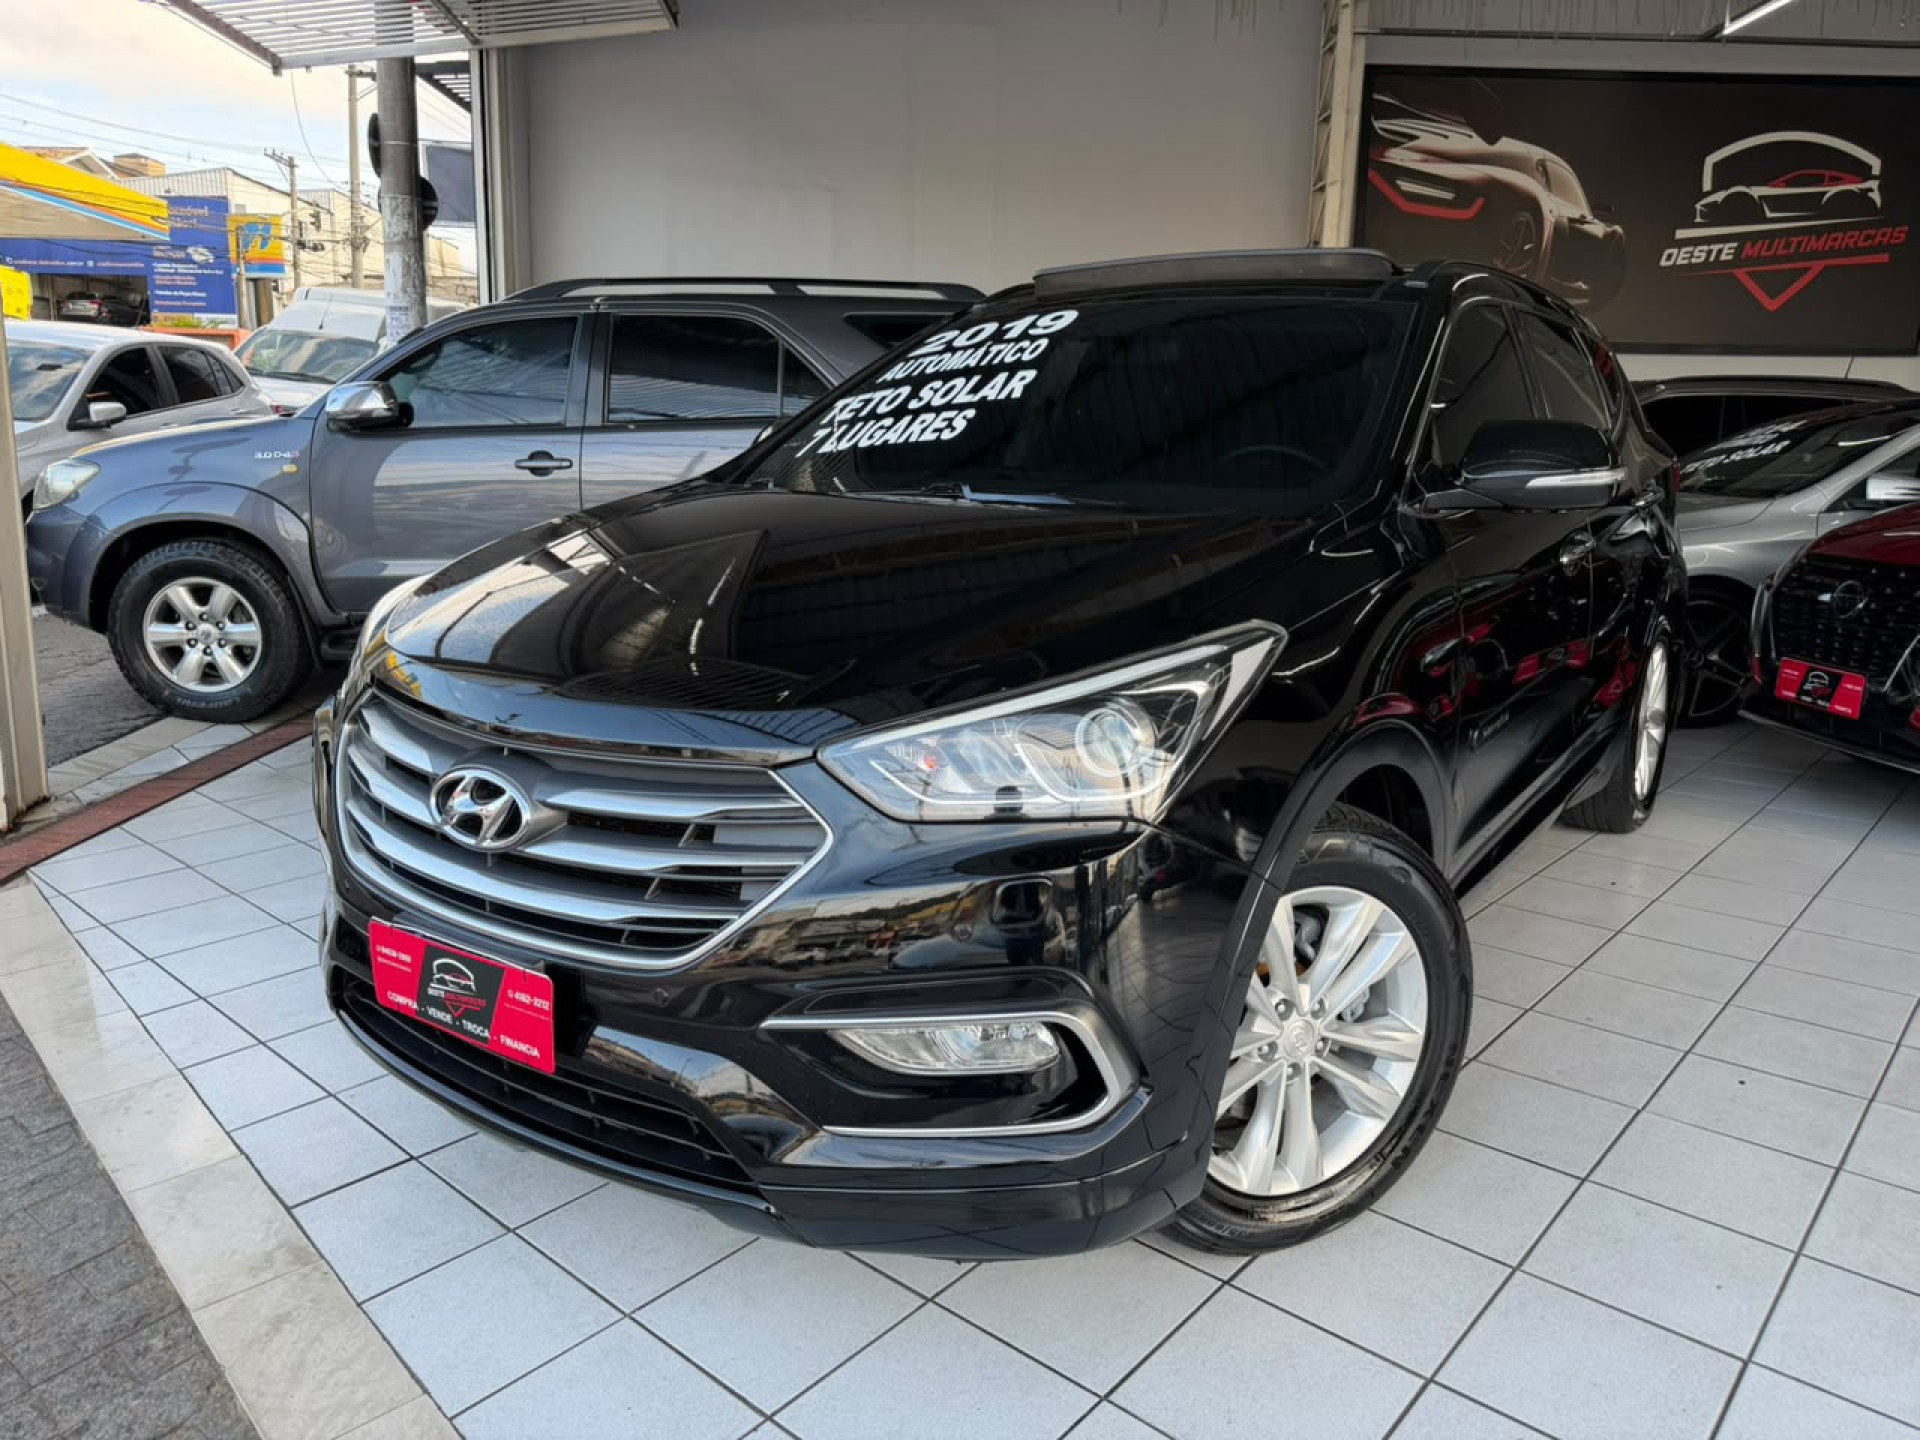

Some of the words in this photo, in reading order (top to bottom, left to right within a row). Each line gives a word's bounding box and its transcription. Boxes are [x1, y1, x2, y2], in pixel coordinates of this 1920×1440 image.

[1659, 242, 1738, 267] OESTE
[1740, 225, 1909, 260] MULTIMARCAS
[908, 309, 1080, 357] 2019
[876, 337, 1049, 384] AUTOMÁTICO
[908, 369, 1038, 410] SOLAR
[795, 427, 833, 458] 7
[817, 409, 976, 454] LUGARES
[462, 1019, 490, 1038] TROCA
[499, 1034, 541, 1059] FINANCIA
